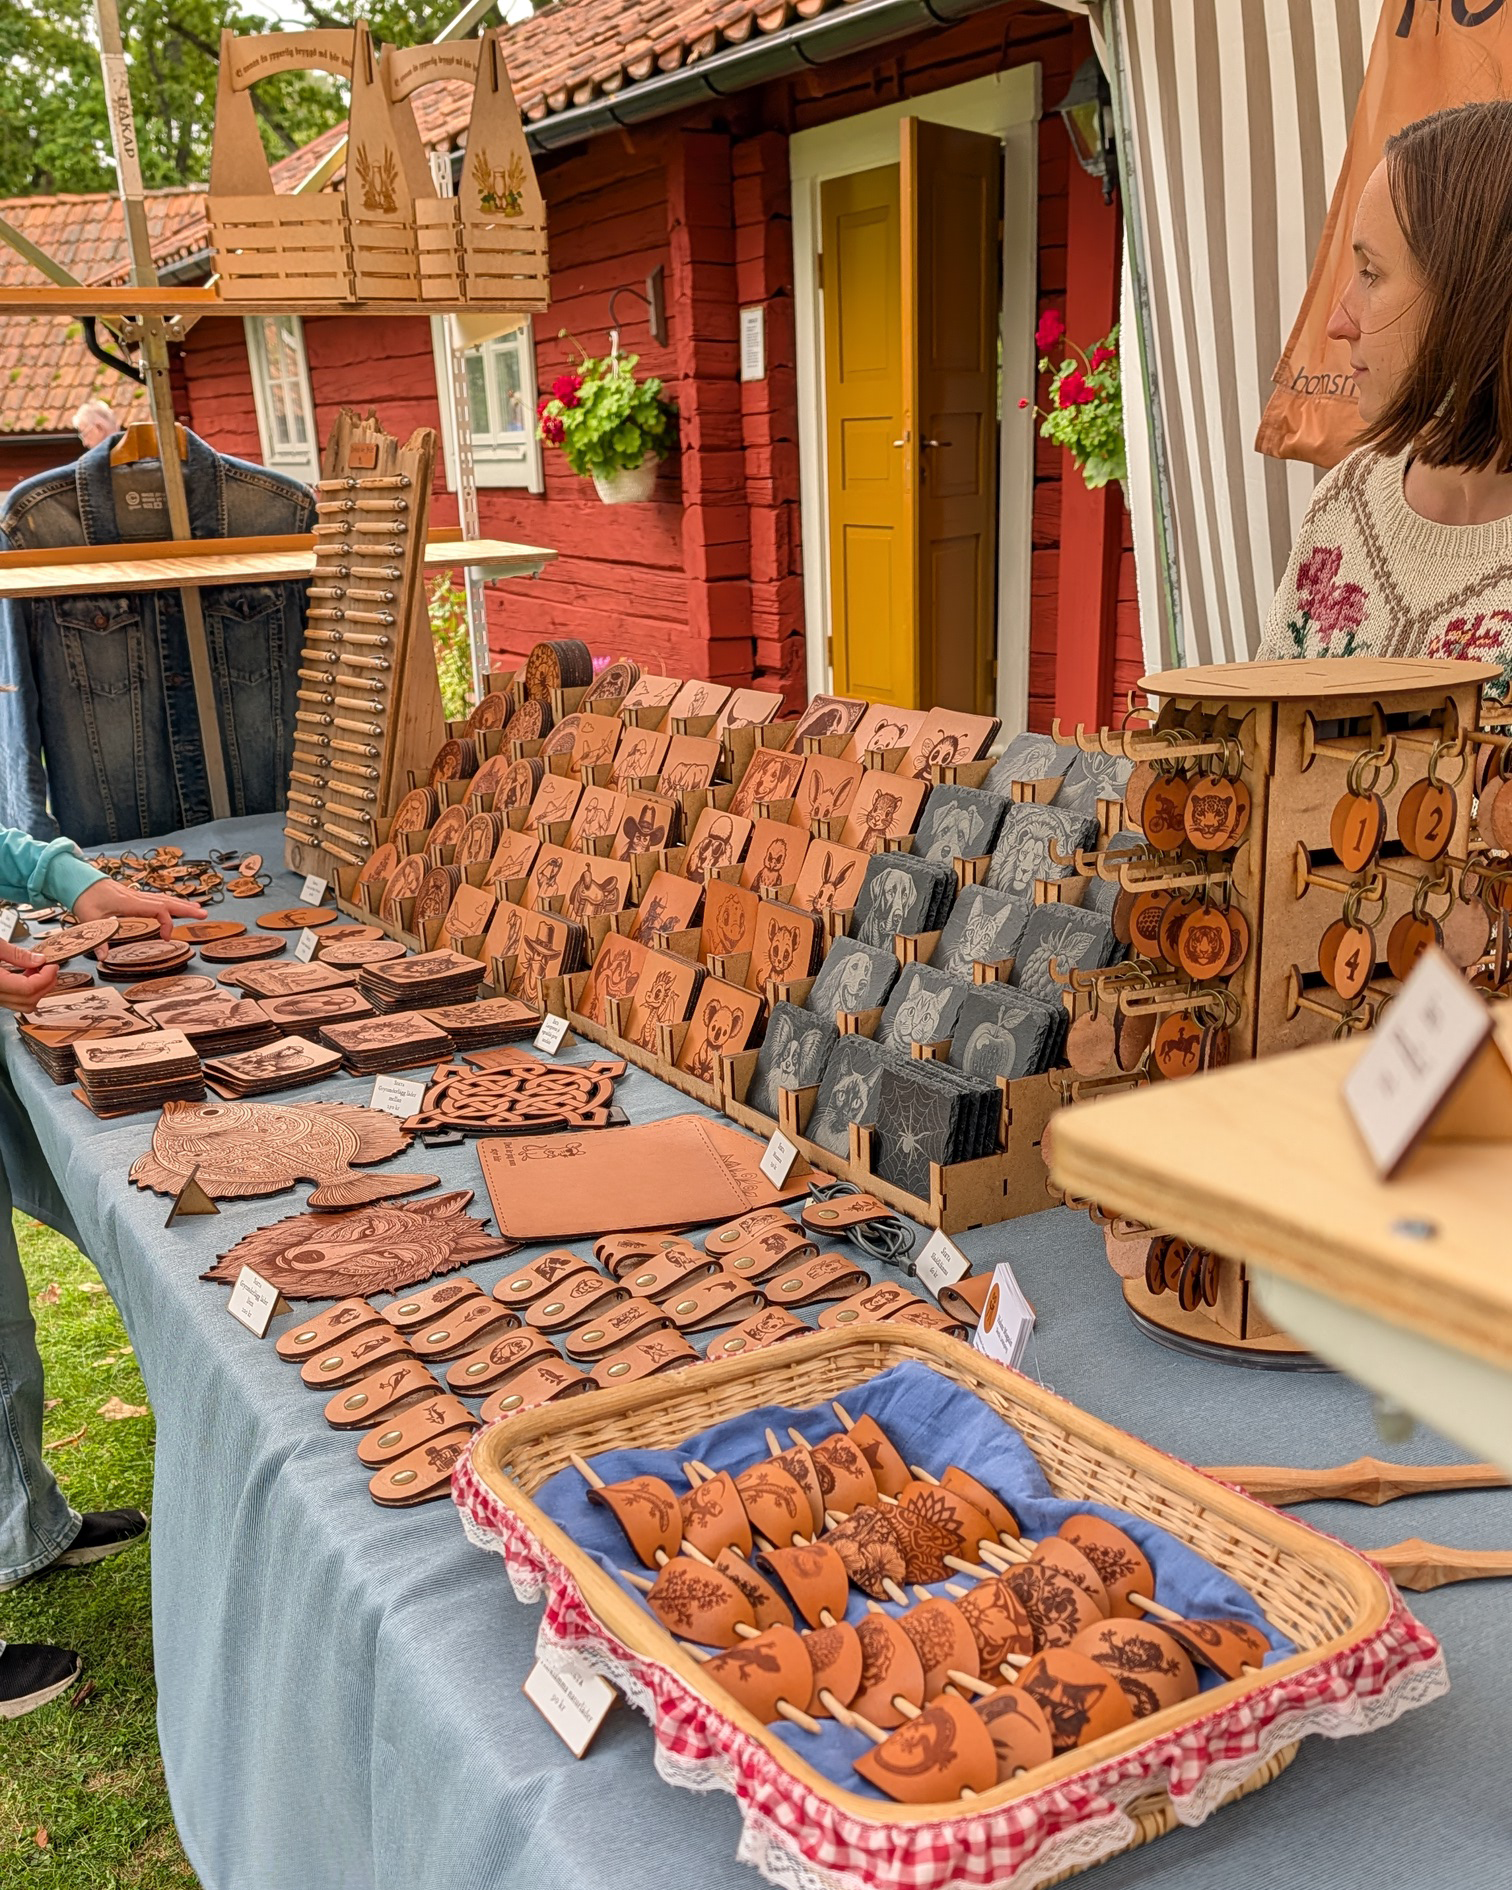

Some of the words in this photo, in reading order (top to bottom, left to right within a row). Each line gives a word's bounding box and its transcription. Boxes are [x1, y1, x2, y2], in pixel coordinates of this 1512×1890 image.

[1352, 817, 1367, 852] 1
[1424, 806, 1443, 842] 2
[1344, 948, 1360, 982] 4
